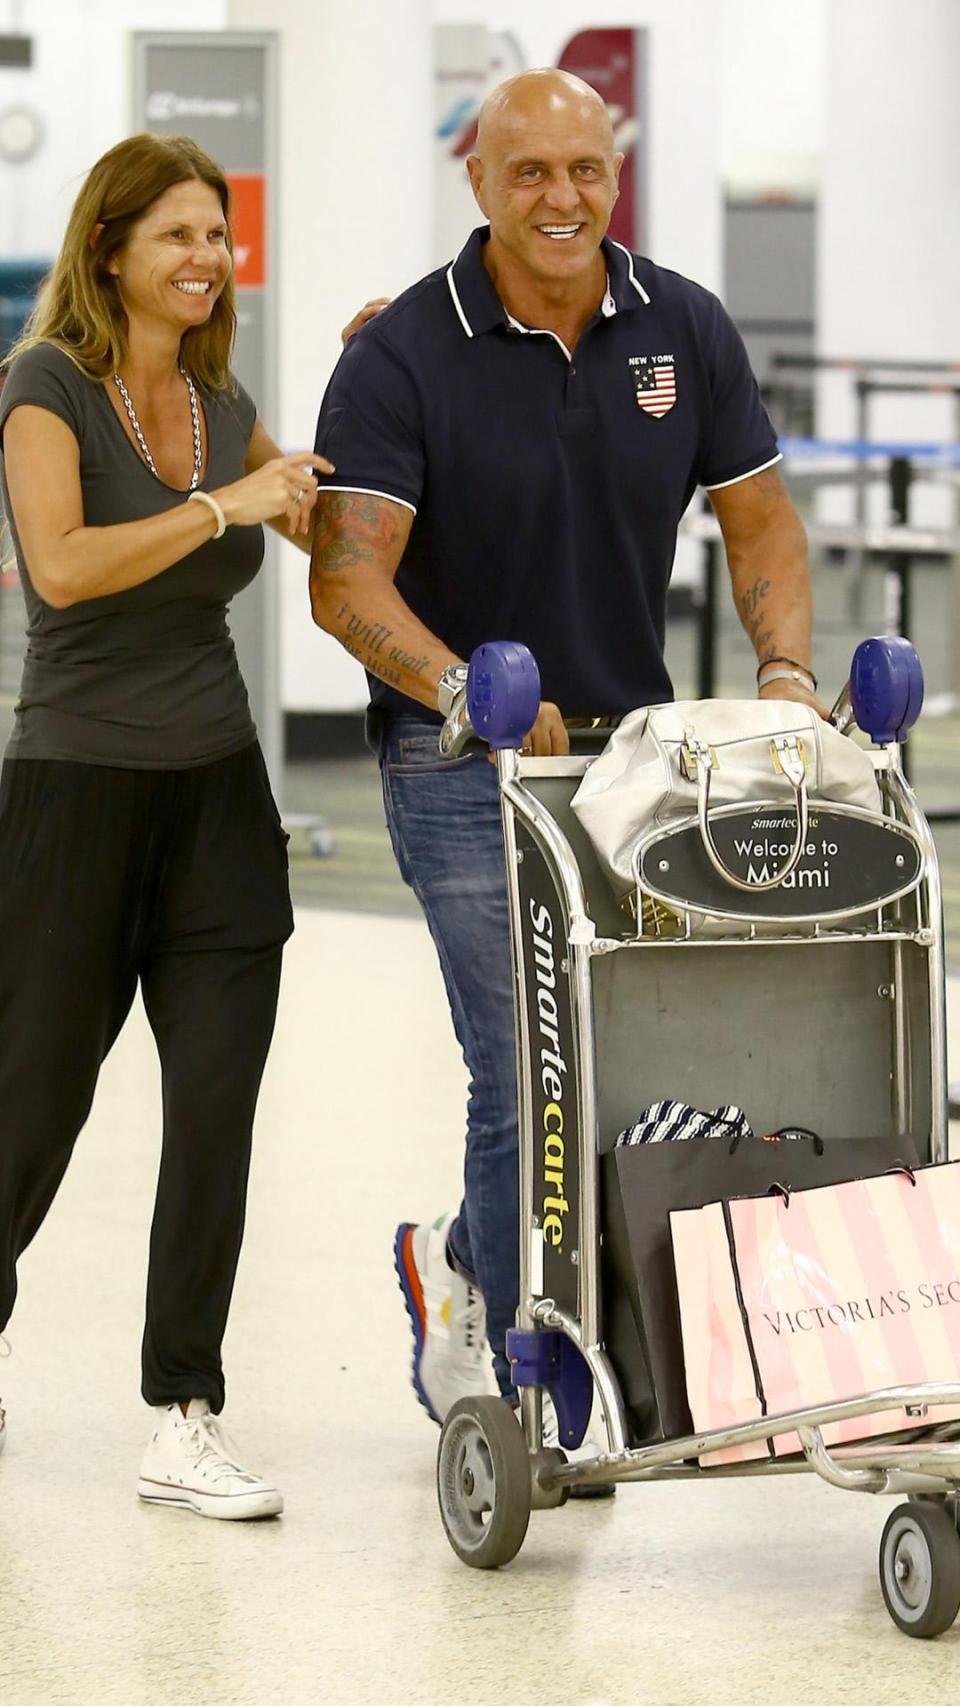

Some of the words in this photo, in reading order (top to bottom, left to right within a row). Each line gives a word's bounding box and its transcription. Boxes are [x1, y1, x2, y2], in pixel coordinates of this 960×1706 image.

[628, 356, 648, 366] NEW
[650, 354, 675, 364] YORK
[346, 614, 393, 653] will
[389, 646, 431, 674] wait
[821, 840, 839, 856] to
[746, 861, 830, 888] Miami
[763, 1290, 911, 1335] VICTORIA'S
